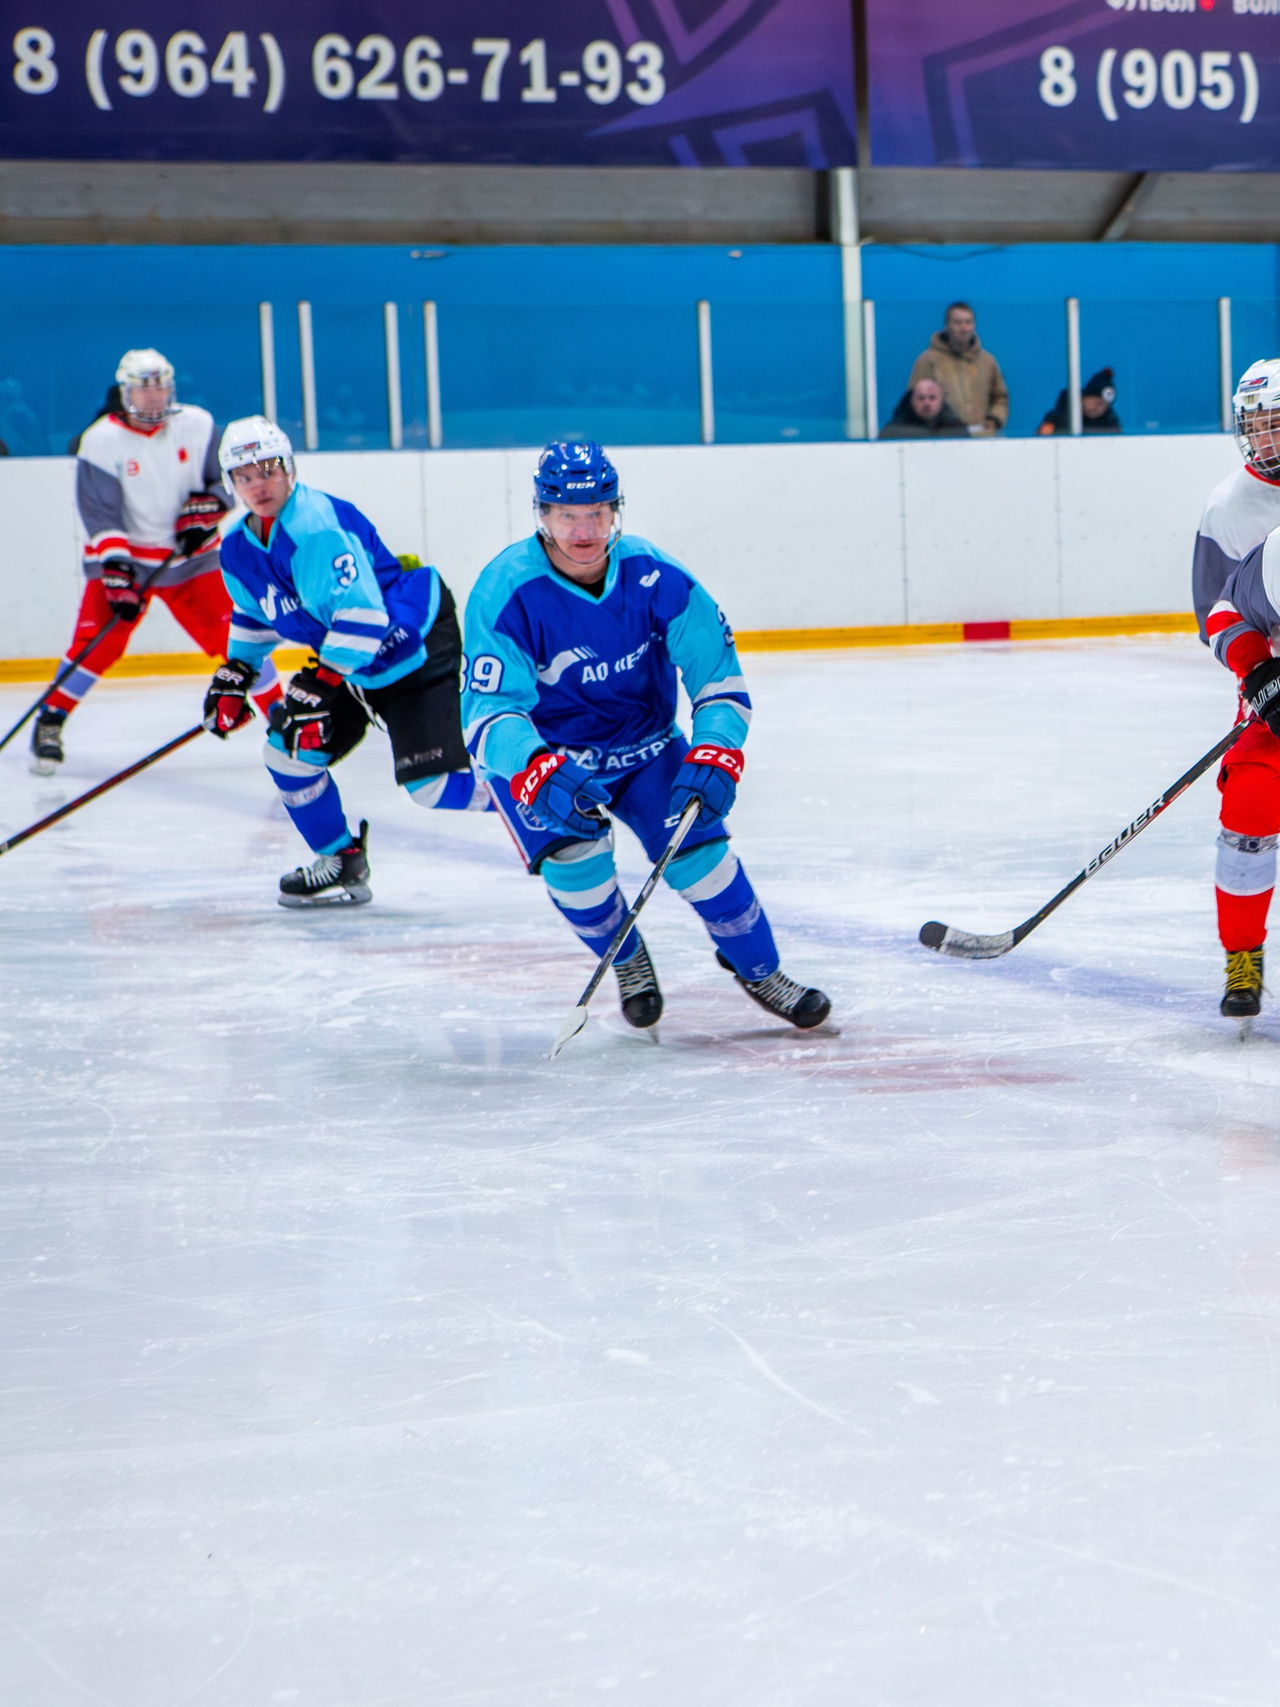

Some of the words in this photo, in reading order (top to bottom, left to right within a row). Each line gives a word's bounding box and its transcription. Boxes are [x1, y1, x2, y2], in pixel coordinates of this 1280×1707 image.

[13, 28, 58, 94] 8
[85, 29, 285, 112] (964)
[311, 34, 667, 105] 626-71-93
[1039, 45, 1077, 107] 8
[1097, 48, 1259, 123] (905)
[334, 553, 358, 587] 3
[581, 661, 609, 685] АО
